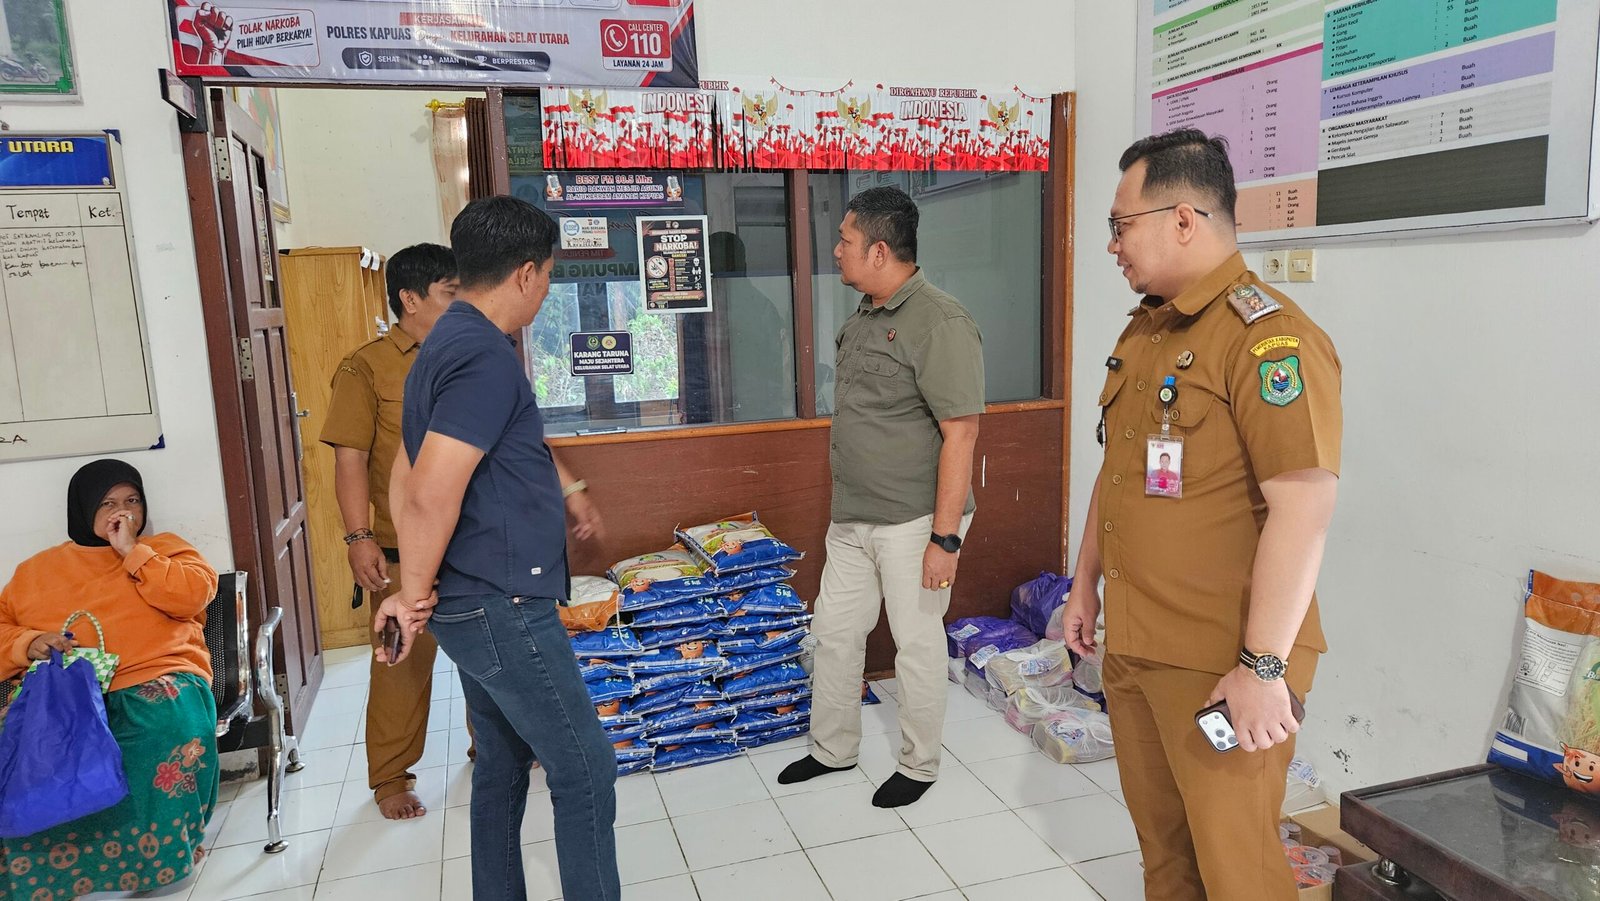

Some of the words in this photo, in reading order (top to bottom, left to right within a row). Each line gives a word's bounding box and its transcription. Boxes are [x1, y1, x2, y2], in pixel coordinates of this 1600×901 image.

[1333, 5, 1351, 16] SARANA
[1348, 10, 1363, 18] Utama
[1464, 6, 1479, 14] Buah
[1463, 14, 1479, 23] Buah
[239, 21, 263, 35] TOLAK
[265, 16, 301, 31] NARKOBA
[628, 23, 642, 31] CALL
[643, 23, 664, 32] CENTER
[1463, 23, 1478, 32] Buah
[236, 36, 254, 49] PILIH
[255, 34, 275, 47] HIDUP
[276, 29, 312, 43] BERKARYA!
[327, 26, 367, 39] POLRES
[370, 27, 411, 40] KAPUAS
[450, 31, 507, 43] KELURAHAN
[509, 32, 537, 44] SELAT
[539, 33, 570, 45] UTARA
[1335, 34, 1357, 45] Jembatan
[1462, 34, 1477, 42] Buah
[630, 33, 662, 55] 110
[378, 55, 401, 63] SEHAT
[439, 56, 460, 64] AMAN
[492, 57, 536, 66] BERPRESTASI
[613, 60, 641, 68] LAYANAN
[642, 60, 650, 68] 24
[650, 60, 664, 69] JAM
[1357, 62, 1367, 70] Jasa
[1461, 63, 1476, 71] Buah
[1329, 82, 1352, 93] LEMBAGA
[1352, 74, 1388, 89] KETERAMPILAN
[1388, 69, 1409, 79] KHUSUS
[1461, 73, 1476, 81] Buah
[1460, 82, 1475, 90] Buah
[890, 87, 937, 98] DIRGAHAYU
[939, 88, 978, 98] REPUBLIK
[1336, 92, 1351, 100] Kursus
[1351, 86, 1374, 98] Komputer
[1335, 108, 1355, 118] Lembaga
[1355, 101, 1386, 114] Keterampilan
[1385, 98, 1402, 106] Kursus
[1401, 93, 1421, 104] Lainnya
[1336, 101, 1351, 109] Kursus
[1351, 98, 1367, 106] Bahasa
[1367, 94, 1383, 103] Inggris
[899, 99, 968, 121] INDONESIA
[1459, 107, 1474, 115] Buah
[1328, 121, 1356, 132] ORGANISASI
[1356, 115, 1389, 127] MASYARAKAT
[1459, 115, 1473, 123] Buah
[1331, 130, 1353, 139] Kelompok
[1353, 125, 1375, 136] Pengajian
[1385, 119, 1410, 129] Salawatan
[1458, 123, 1473, 131] Buah
[1331, 139, 1347, 147] Majelis
[1346, 136, 1363, 144] Jemaat
[1363, 133, 1378, 142] Gereja
[1457, 132, 1473, 140] Buah
[8, 140, 74, 153] UTARA
[576, 175, 599, 184] BEST
[601, 175, 614, 184] FM
[635, 175, 653, 184] Mhz
[588, 185, 616, 193] DAKWAH
[6, 204, 50, 222] Tempat
[88, 205, 115, 219] Ket.
[660, 234, 688, 243] STOP
[656, 241, 697, 251] NARKOBA!
[1252, 338, 1275, 353] PEMERINTAH
[1263, 341, 1289, 350] KAPUAS
[574, 351, 602, 359] KARANG
[602, 350, 629, 358] TARUNA
[783, 590, 792, 598] kg
